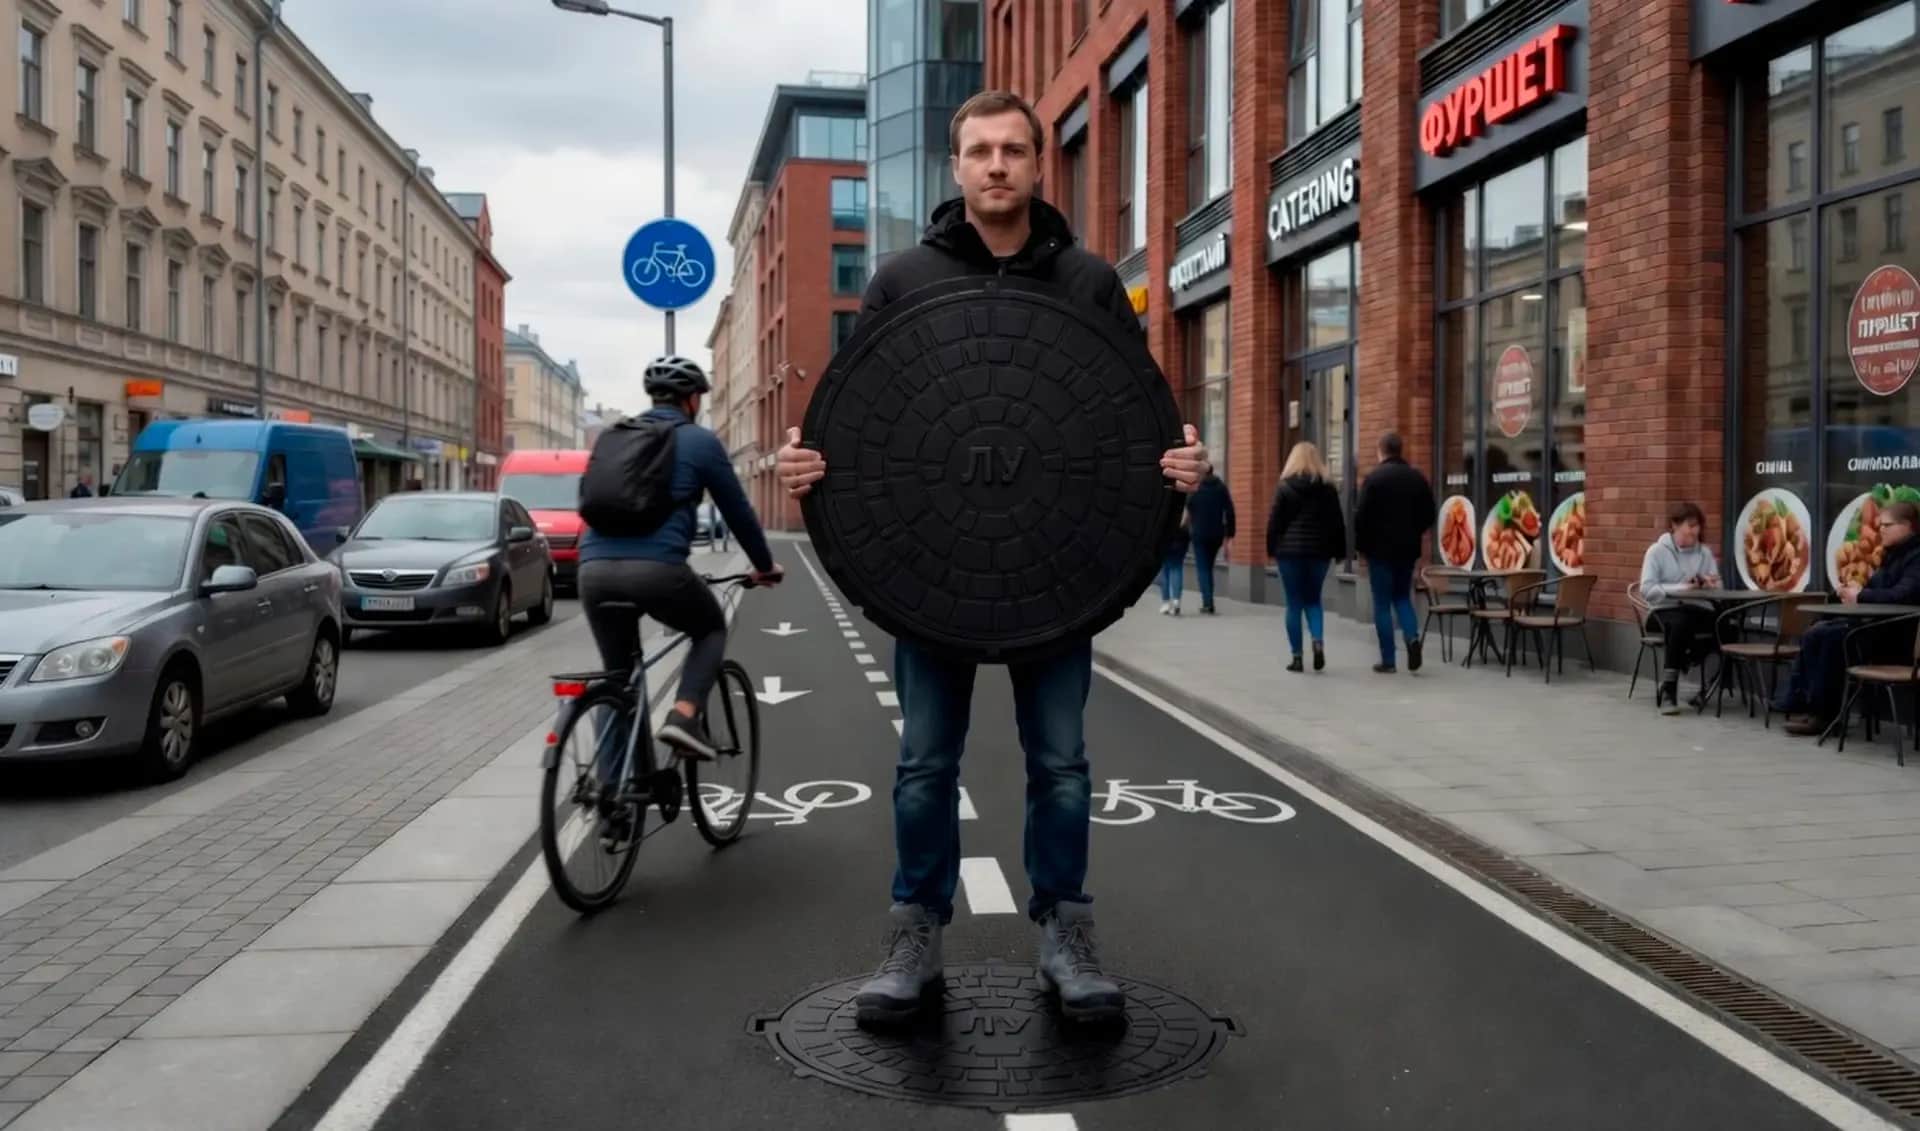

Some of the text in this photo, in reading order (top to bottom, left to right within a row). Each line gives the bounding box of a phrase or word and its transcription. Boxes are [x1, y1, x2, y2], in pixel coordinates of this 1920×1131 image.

[1420, 24, 1568, 157] ФУРШЕТ
[1268, 158, 1354, 240] CATERING
[960, 445, 1026, 484] ЛУ
[959, 1015, 1032, 1035] ЛУ
